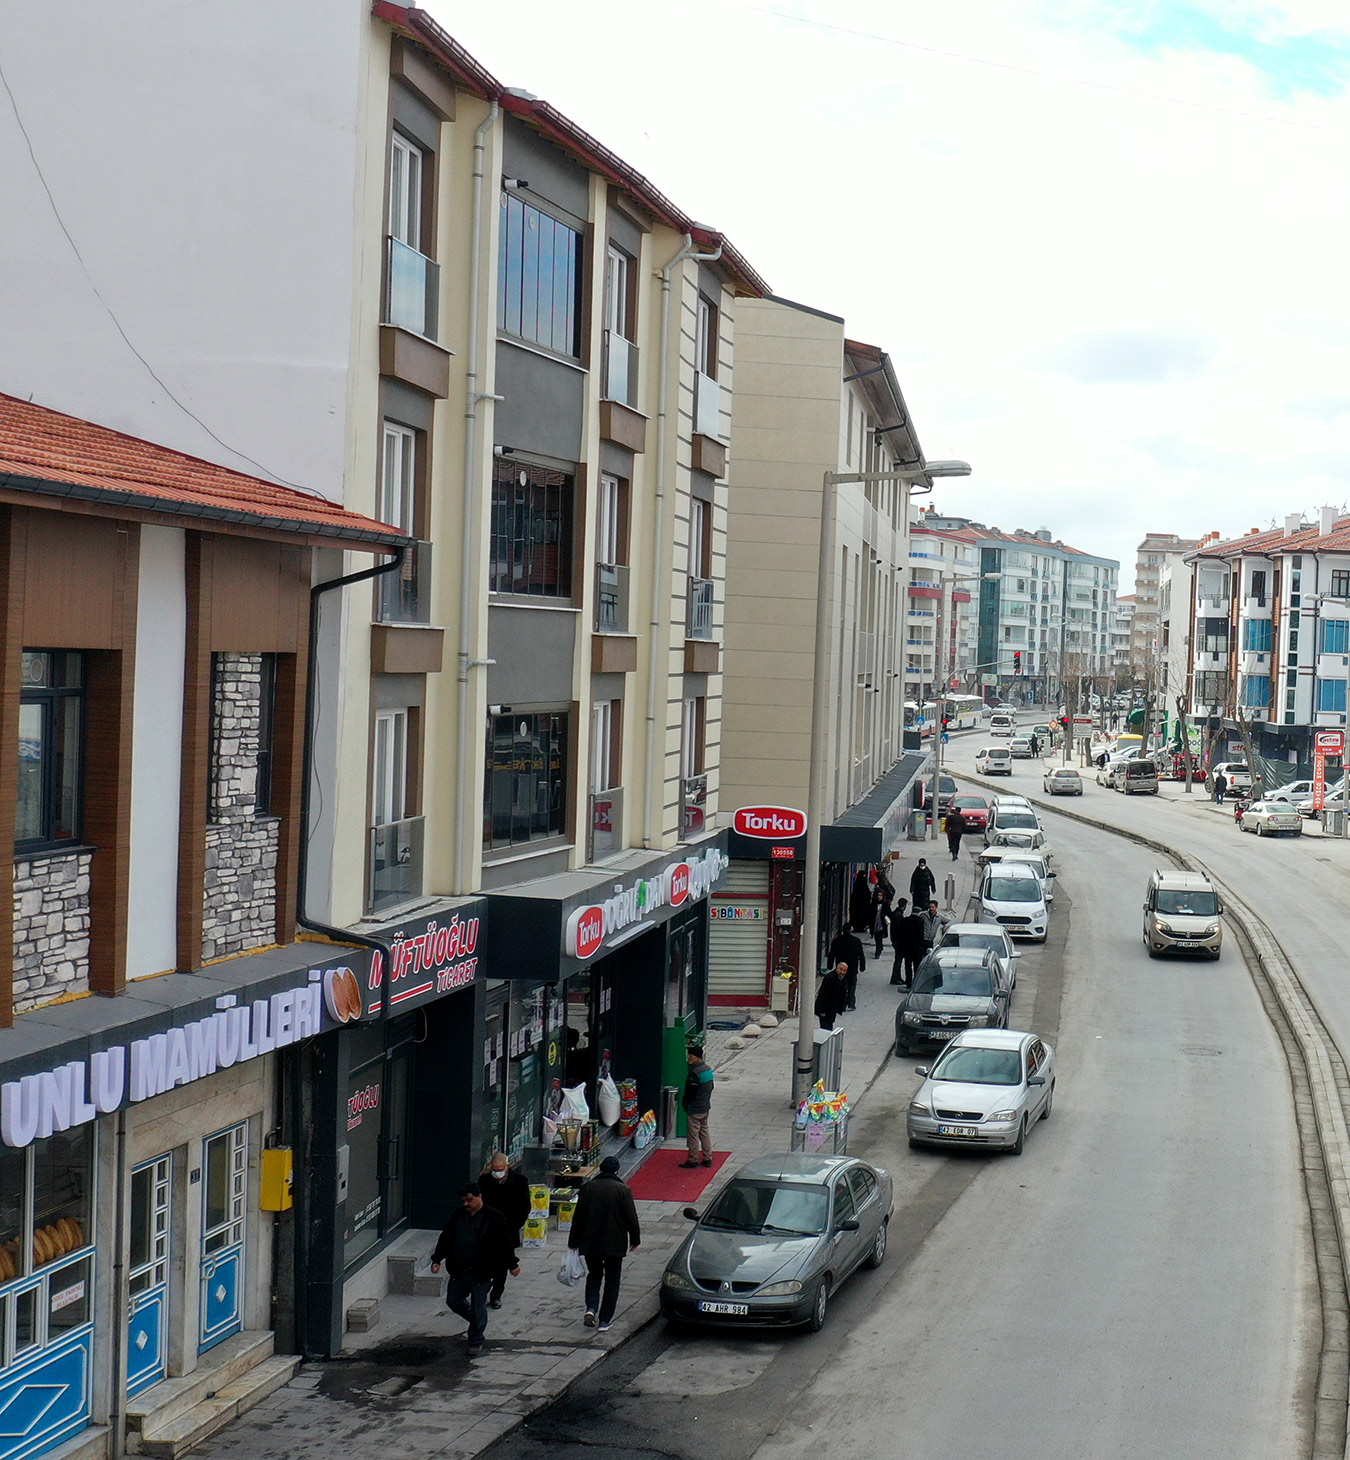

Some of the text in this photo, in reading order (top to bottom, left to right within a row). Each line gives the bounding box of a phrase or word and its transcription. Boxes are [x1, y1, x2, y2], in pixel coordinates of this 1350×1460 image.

[742, 812, 796, 831] Torku
[578, 918, 600, 948] Torku
[672, 871, 688, 895] Torku
[436, 956, 479, 994] TİCARET
[1, 969, 322, 1149] UNLU MAMÜLLERİ
[703, 1303, 747, 1314] 42 AHR 984
